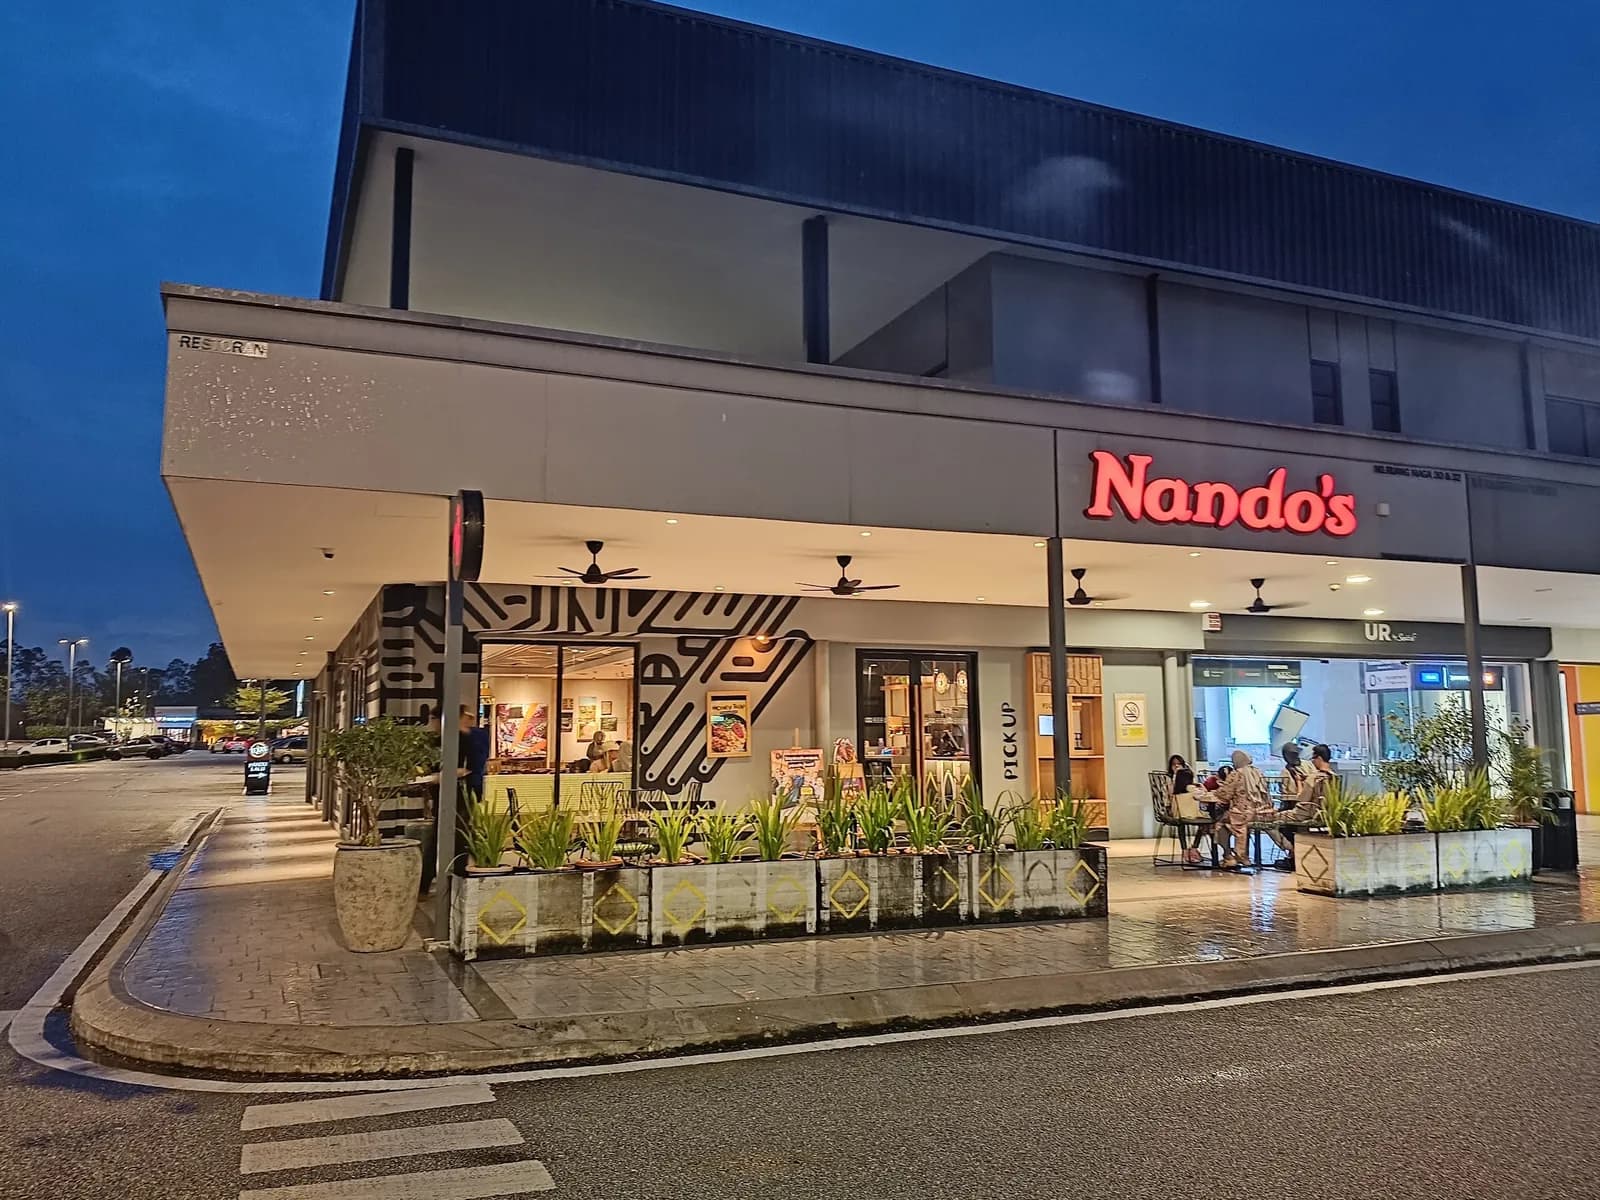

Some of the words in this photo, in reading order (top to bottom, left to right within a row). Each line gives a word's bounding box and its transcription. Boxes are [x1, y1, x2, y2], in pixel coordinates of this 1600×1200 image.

[1086, 450, 1357, 536] Nando's
[1364, 622, 1392, 641] UR
[1001, 702, 1016, 727] UP
[1003, 732, 1018, 779] PICK
